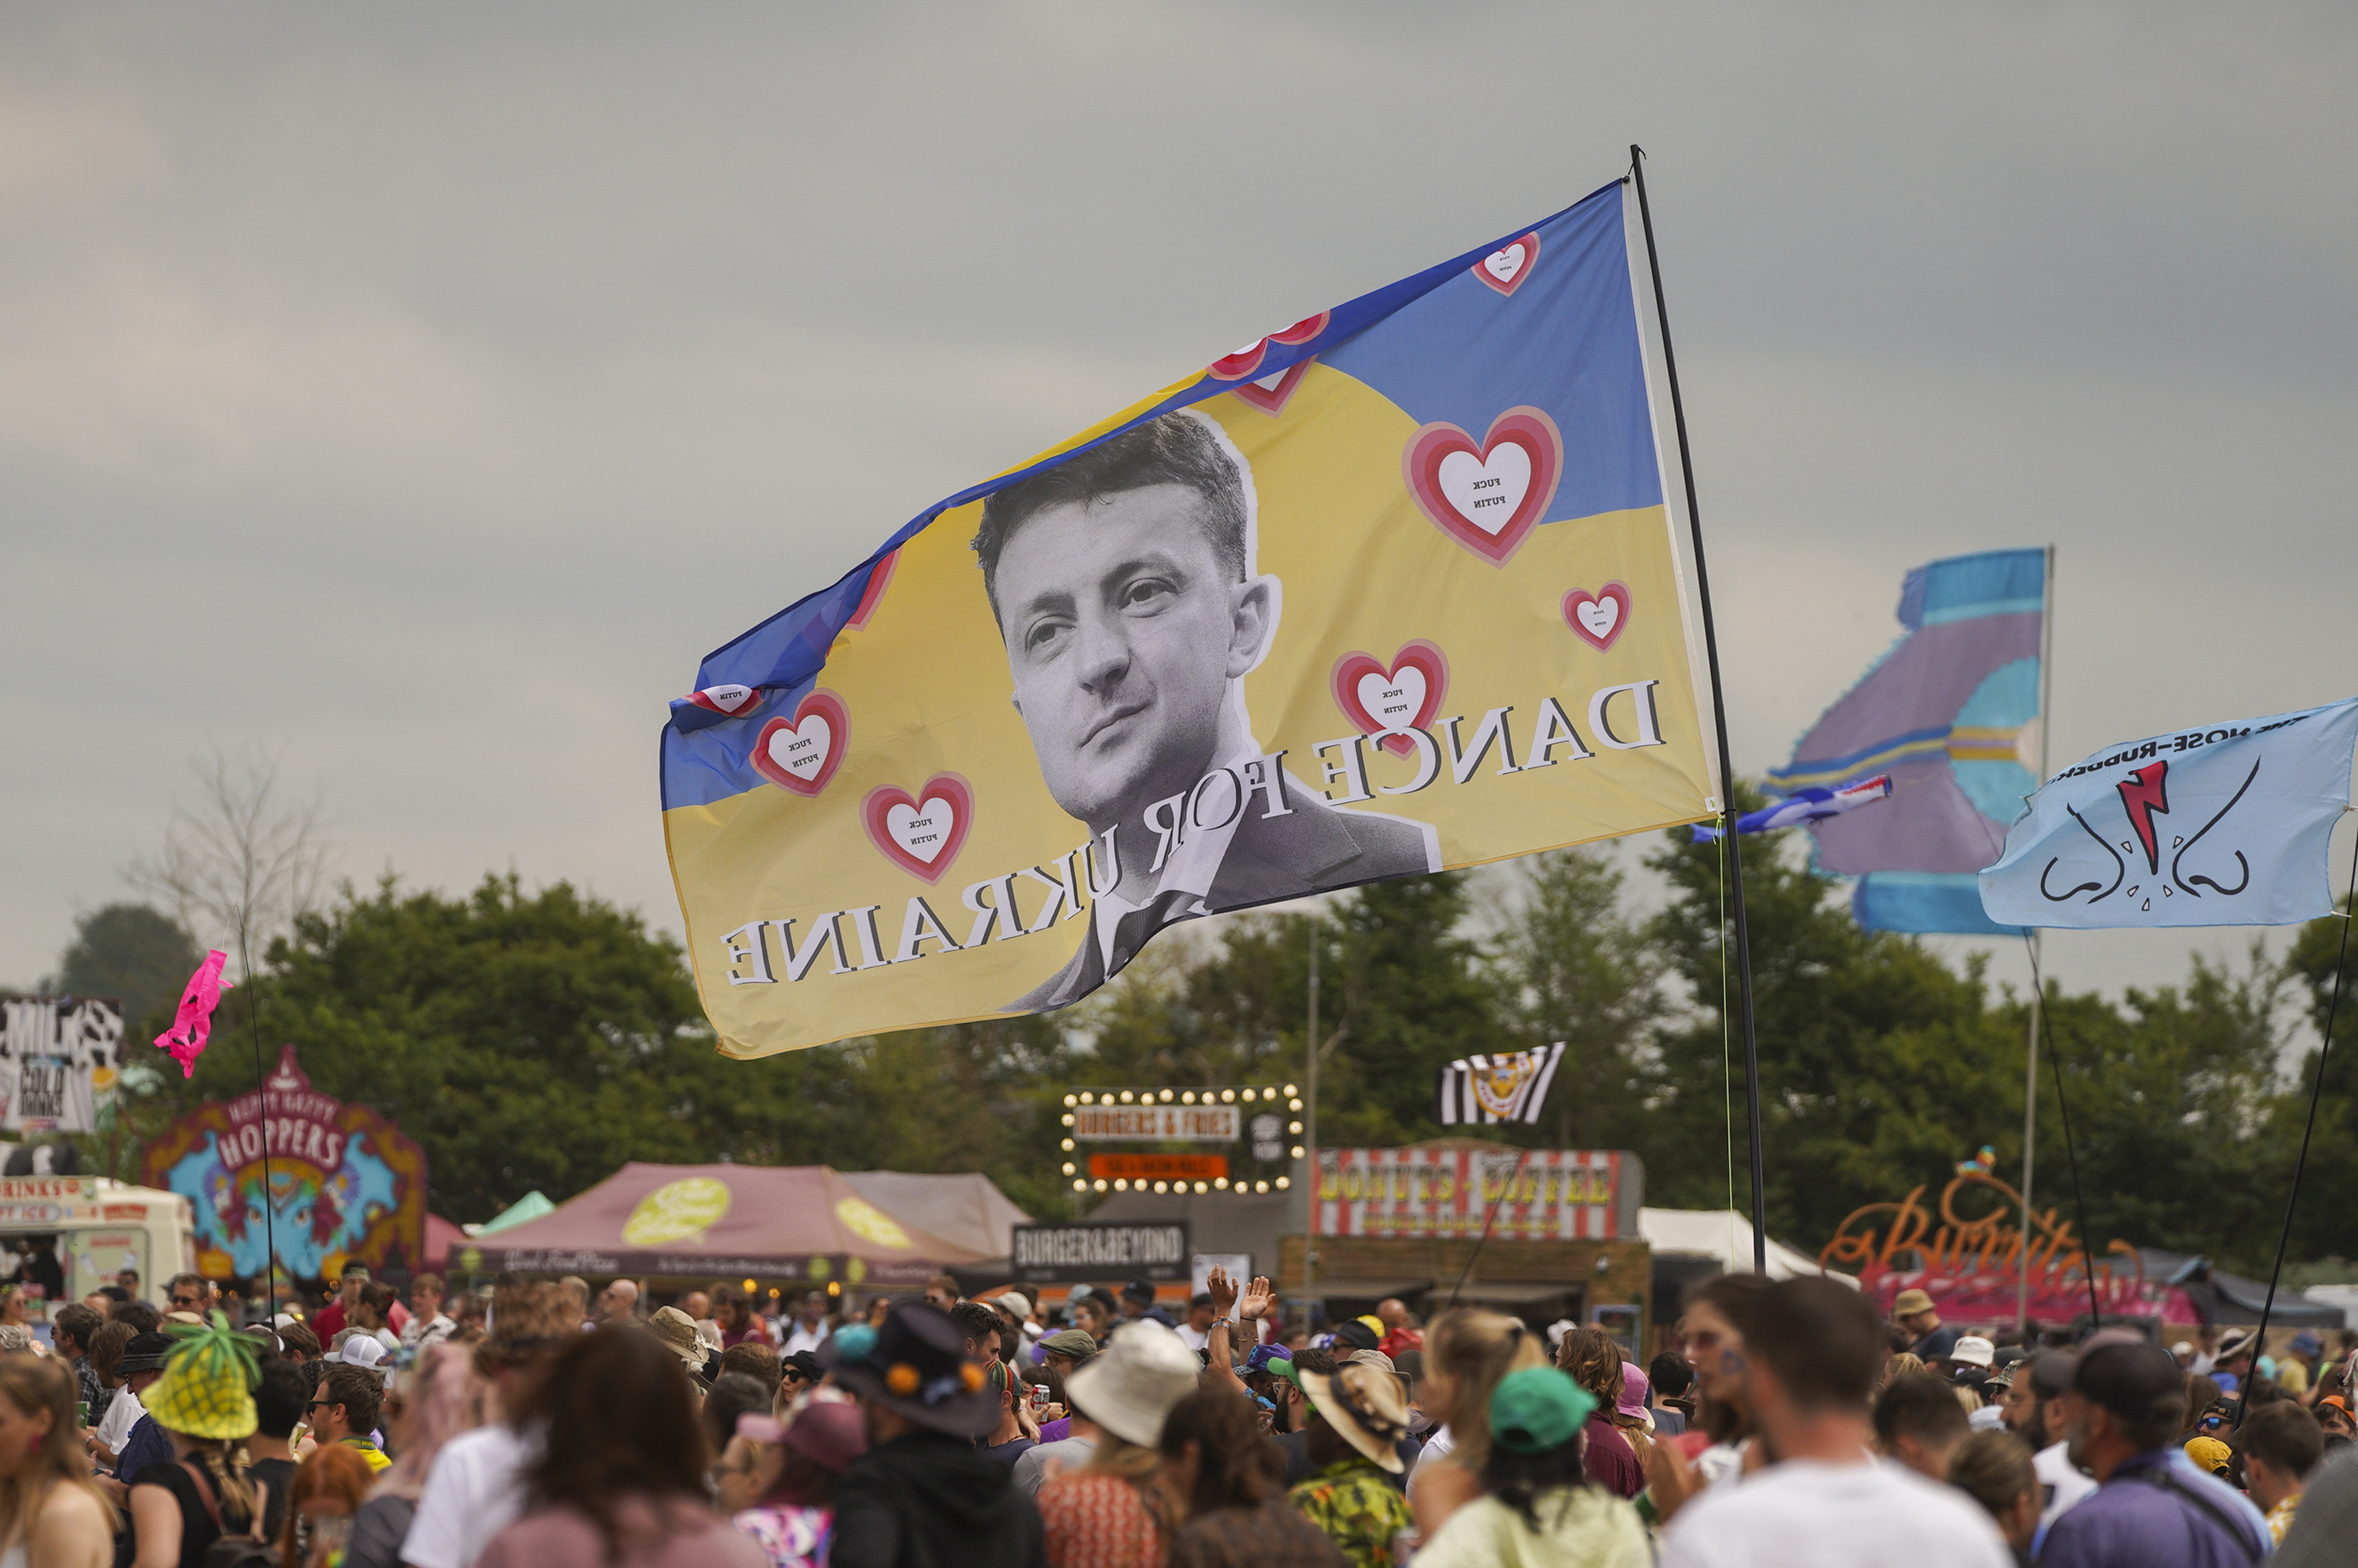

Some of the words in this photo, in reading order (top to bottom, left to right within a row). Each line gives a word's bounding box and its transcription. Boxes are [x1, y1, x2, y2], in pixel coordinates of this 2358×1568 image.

[21, 1066, 64, 1095] COLD
[1076, 1110, 1156, 1135] BURGERS
[1182, 1110, 1231, 1135] FRIES
[218, 1117, 343, 1170] HOPPERS
[0, 1180, 62, 1197] RINKS
[1319, 1163, 1455, 1203] DONUTS
[1481, 1165, 1611, 1206] COFFEE
